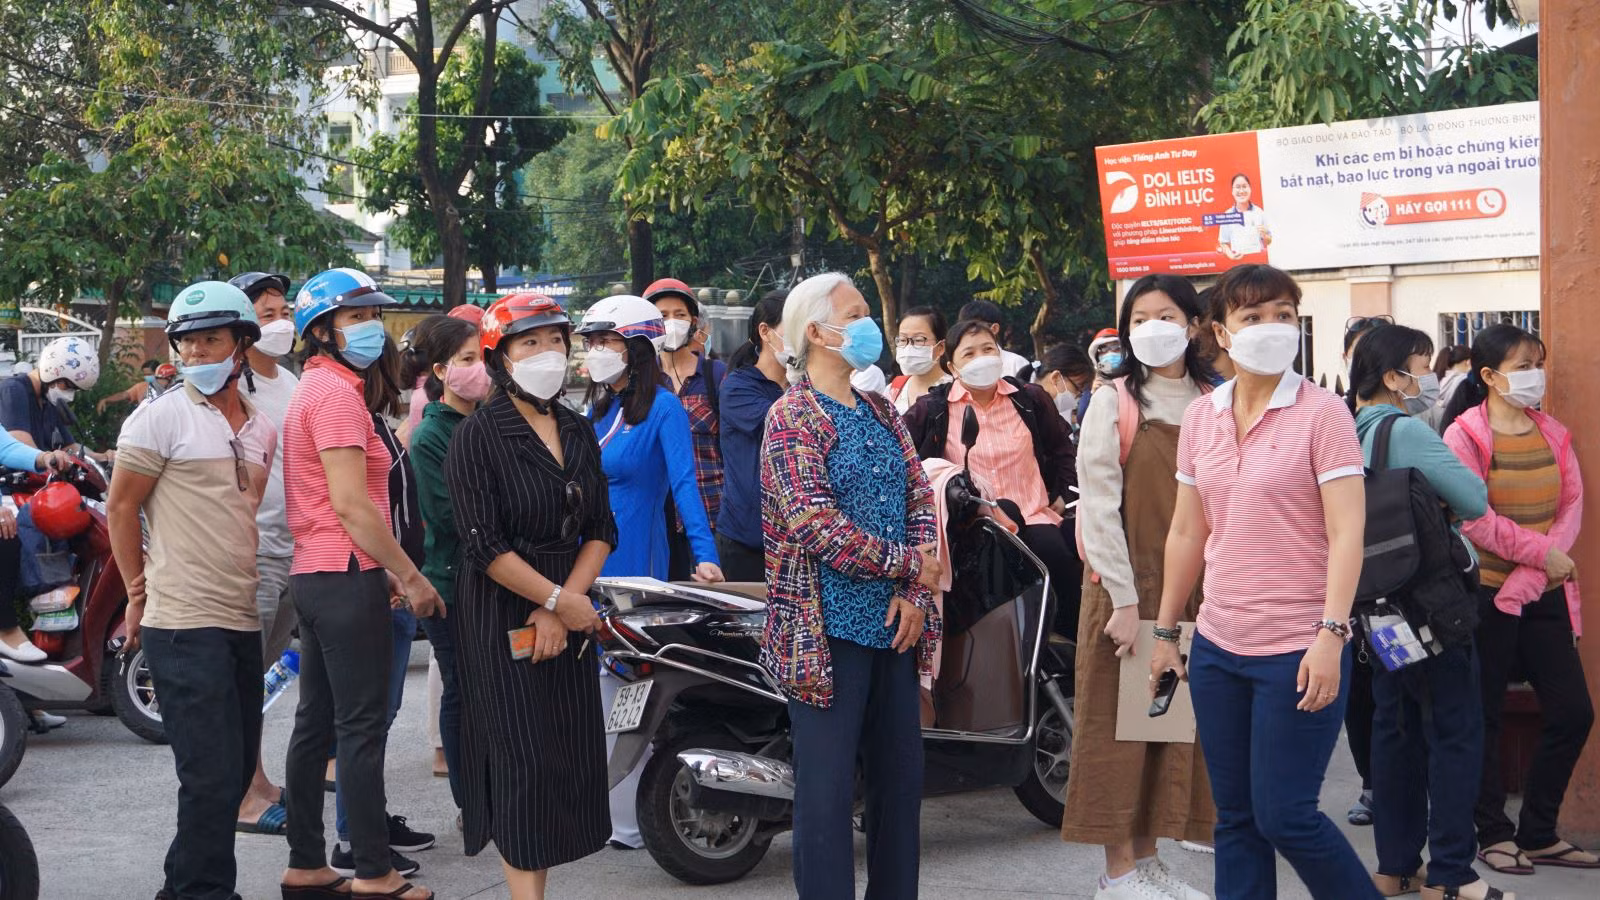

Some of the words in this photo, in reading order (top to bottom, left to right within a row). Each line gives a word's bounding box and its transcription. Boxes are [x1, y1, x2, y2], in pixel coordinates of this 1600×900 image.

[1182, 149, 1197, 158] Duy
[1315, 153, 1339, 167] Khi
[1343, 151, 1369, 165] các
[1373, 151, 1395, 162] em
[1399, 146, 1412, 162] bị
[1416, 143, 1453, 159] hoặc
[1457, 139, 1505, 154] chứng
[1143, 171, 1174, 188] DOL
[1177, 168, 1215, 186] IELTS
[1307, 173, 1334, 188] nạt,
[1337, 171, 1363, 186] bạo
[1367, 169, 1389, 184] lực
[1393, 165, 1432, 179] trong
[1436, 161, 1454, 175] và
[1458, 156, 1500, 175] ngoài
[1504, 154, 1541, 169] trườ
[1144, 188, 1181, 208] ĐÌNH
[1184, 187, 1214, 207] LỰC
[1395, 201, 1422, 216] HÃY
[1424, 200, 1448, 214] GỌI
[1450, 198, 1472, 212] 111
[617, 683, 646, 707] 59-X3
